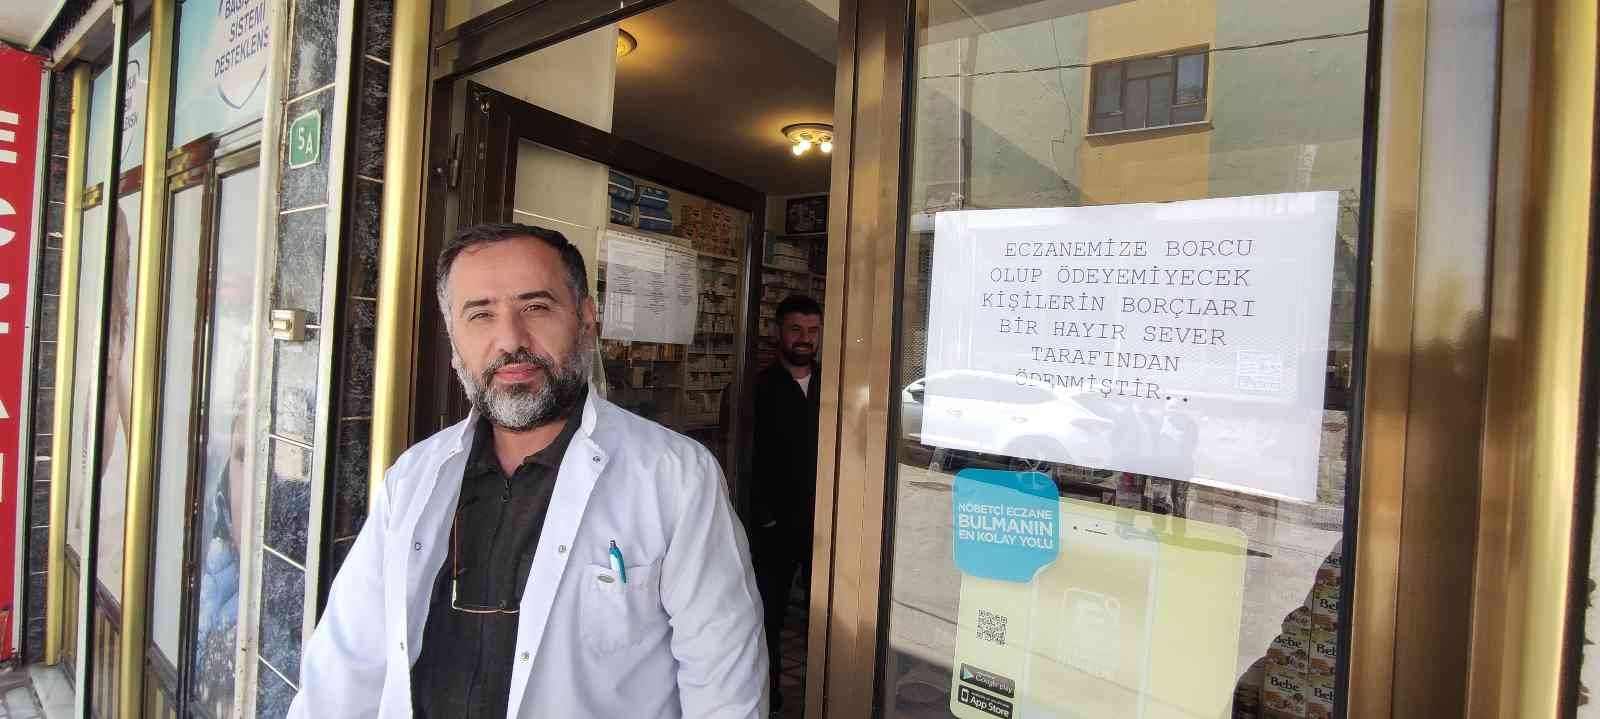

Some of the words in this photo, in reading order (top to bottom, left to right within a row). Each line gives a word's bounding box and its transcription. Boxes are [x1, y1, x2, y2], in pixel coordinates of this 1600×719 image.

[1003, 238, 1148, 257] ECZANEMİZE
[1165, 239, 1253, 257] BORCU
[989, 266, 1043, 283] OLUP
[1056, 264, 1252, 287] ÖDEYEMİYECEK
[981, 290, 1105, 312] KİŞİLERİN
[1120, 296, 1256, 319] BORÇLARI
[999, 316, 1040, 335] BİR
[1052, 321, 1126, 340] HAYIR
[1143, 325, 1227, 346] SEVER
[1031, 346, 1182, 372] TARAFINDAN
[1006, 505, 1053, 520] ECZANE
[959, 513, 1053, 537] BULMANIN
[959, 529, 976, 541] EN
[977, 532, 1016, 545] KOLAY
[1019, 535, 1053, 550] YOLU
[969, 695, 987, 710] App
[988, 701, 1010, 717] Store
